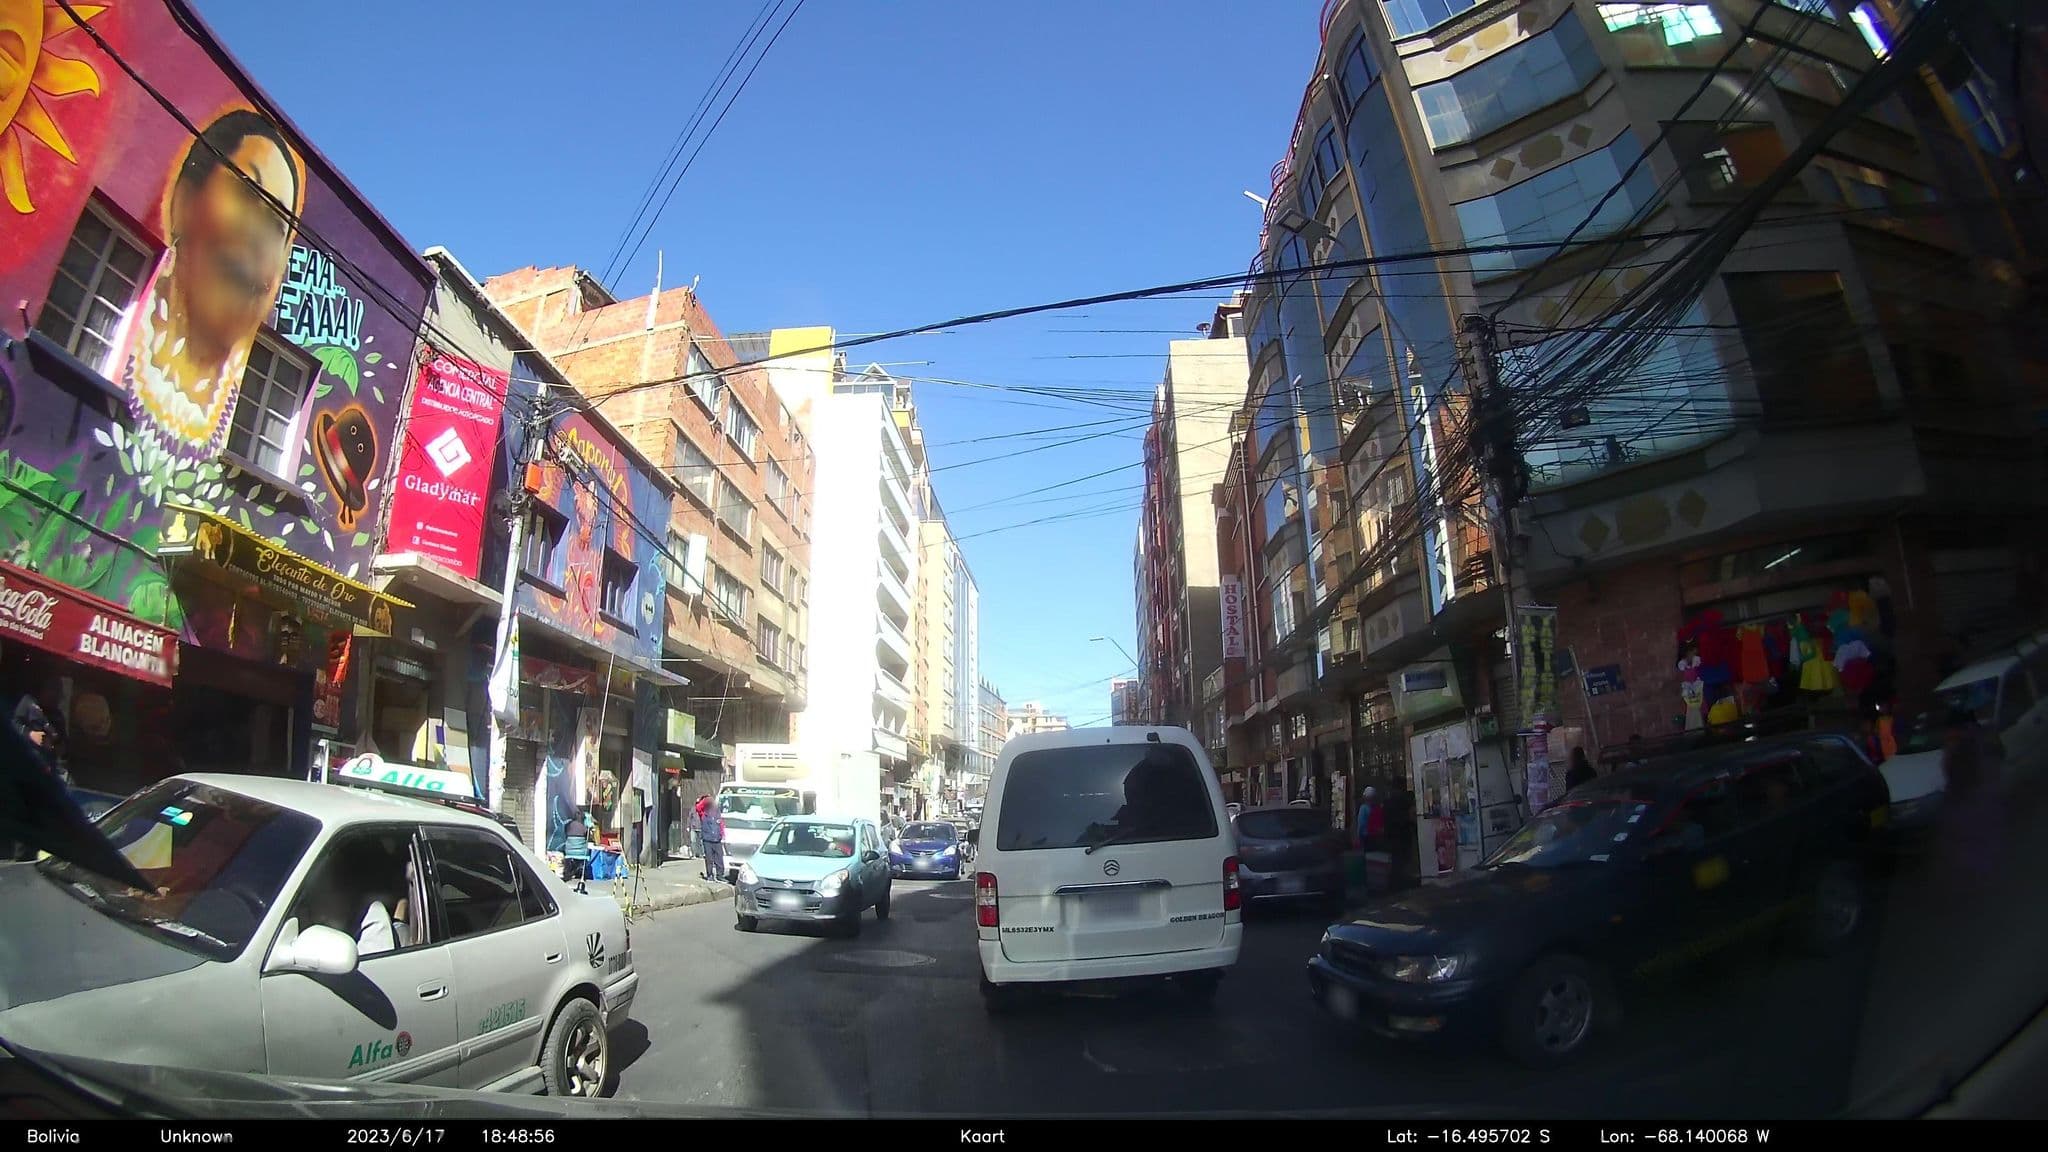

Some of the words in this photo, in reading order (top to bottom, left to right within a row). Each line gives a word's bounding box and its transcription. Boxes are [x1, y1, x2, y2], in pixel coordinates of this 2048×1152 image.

[274, 282, 364, 352] EAAA!
[434, 358, 497, 390] COMERCIAL
[428, 378, 461, 399] AGENCIA
[461, 386, 494, 411] CENTRAL
[404, 474, 478, 506] Gladymar
[256, 546, 313, 584] Elefante
[313, 575, 327, 592] de
[330, 582, 358, 603] Oro
[1223, 583, 1240, 646] HOSTAL
[89, 614, 165, 652] ALMACÉN
[1169, 913, 1198, 924] GOLDEN
[1198, 911, 1225, 922] DRAGON
[347, 1038, 393, 1070] Alfa
